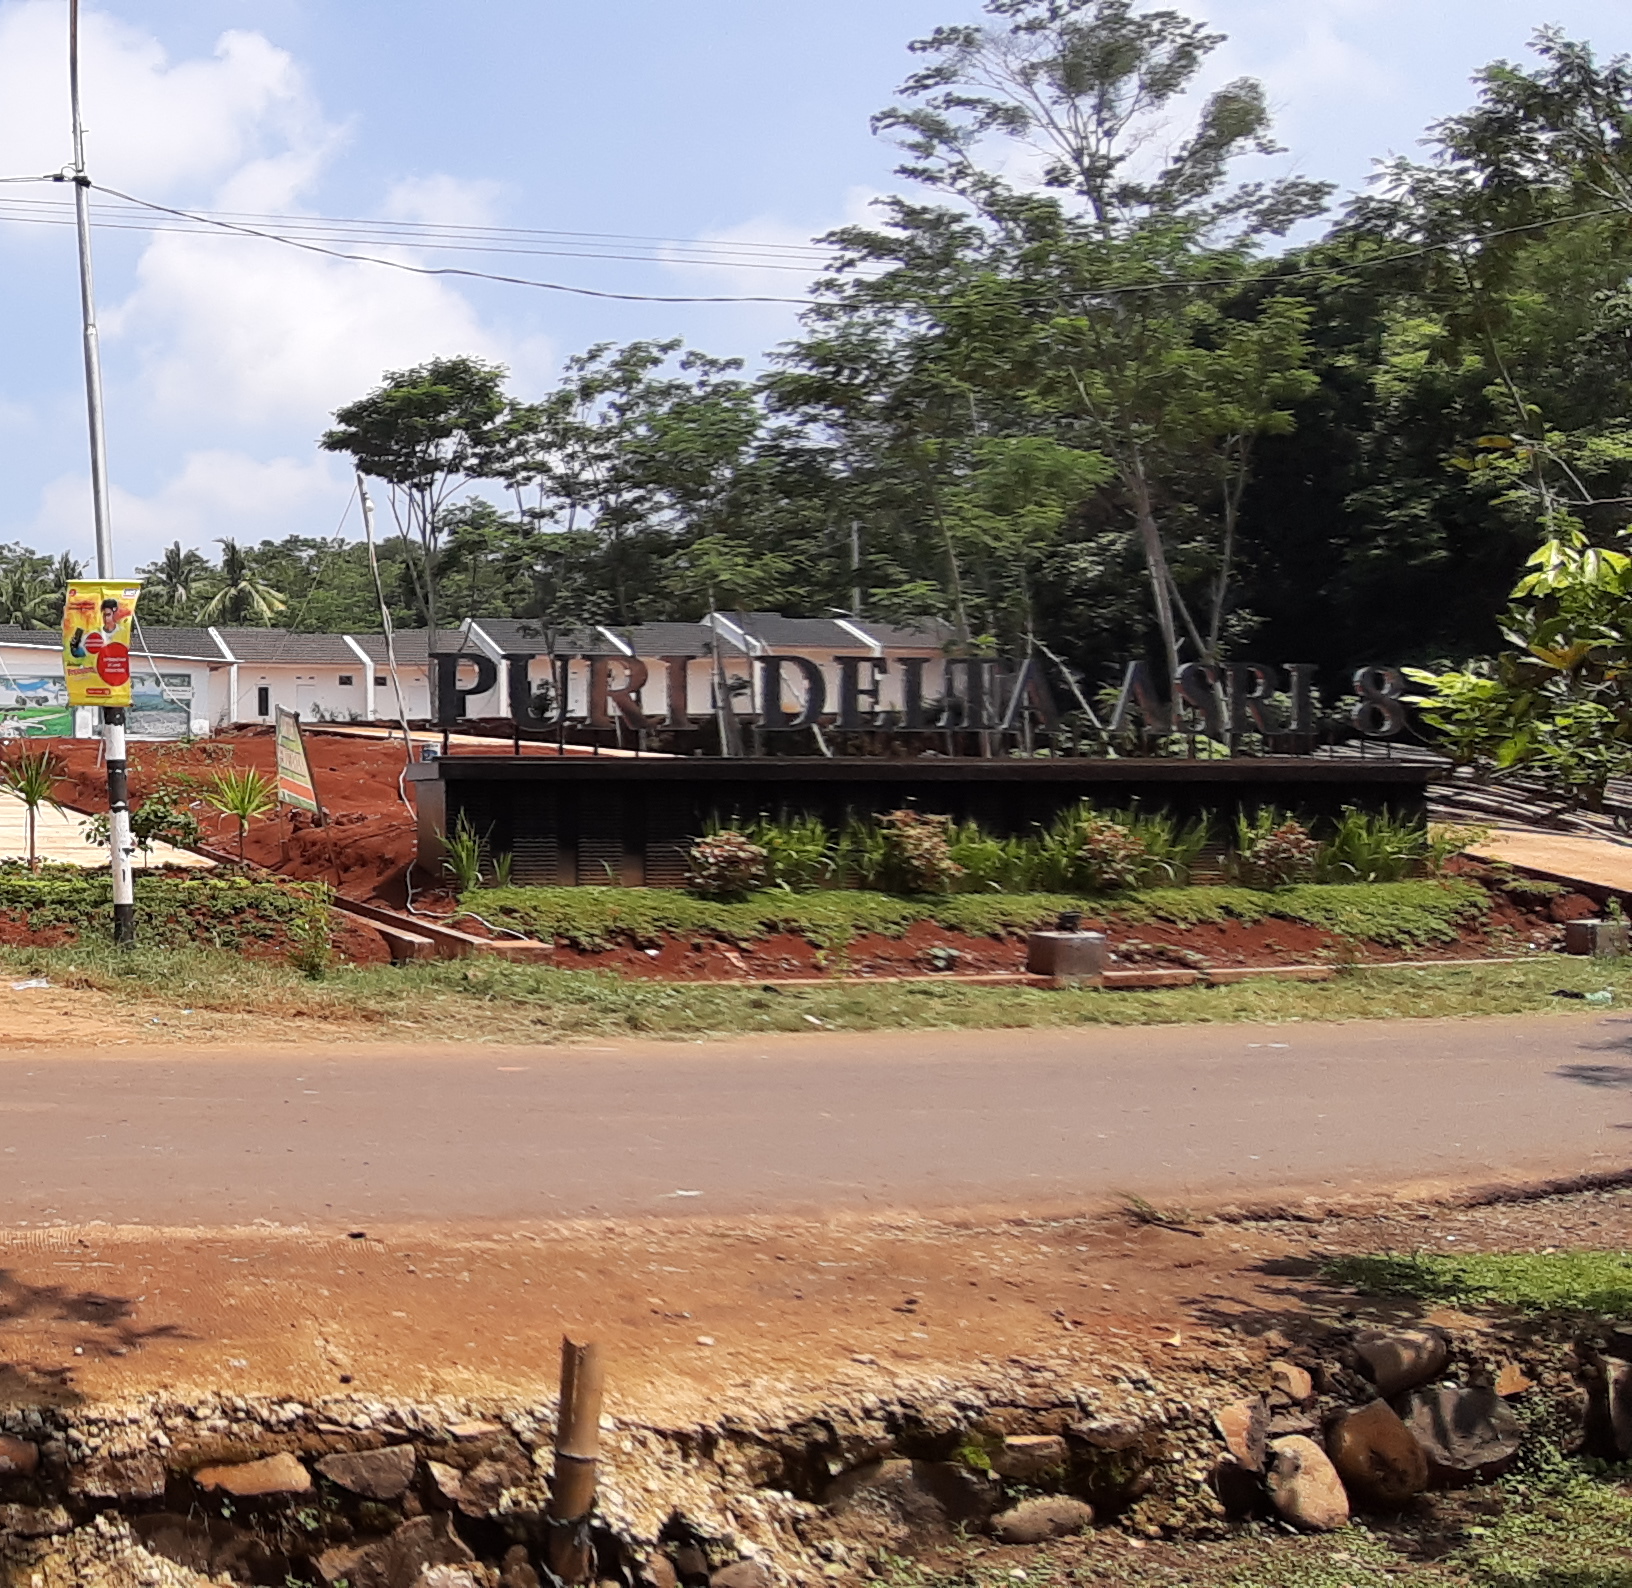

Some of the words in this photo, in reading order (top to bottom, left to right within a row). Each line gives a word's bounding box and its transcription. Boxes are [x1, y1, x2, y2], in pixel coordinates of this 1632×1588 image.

[429, 652, 697, 730] PURI
[754, 655, 1064, 733] DELTA
[1107, 660, 1321, 737] ASRI
[1351, 664, 1408, 737] 8
